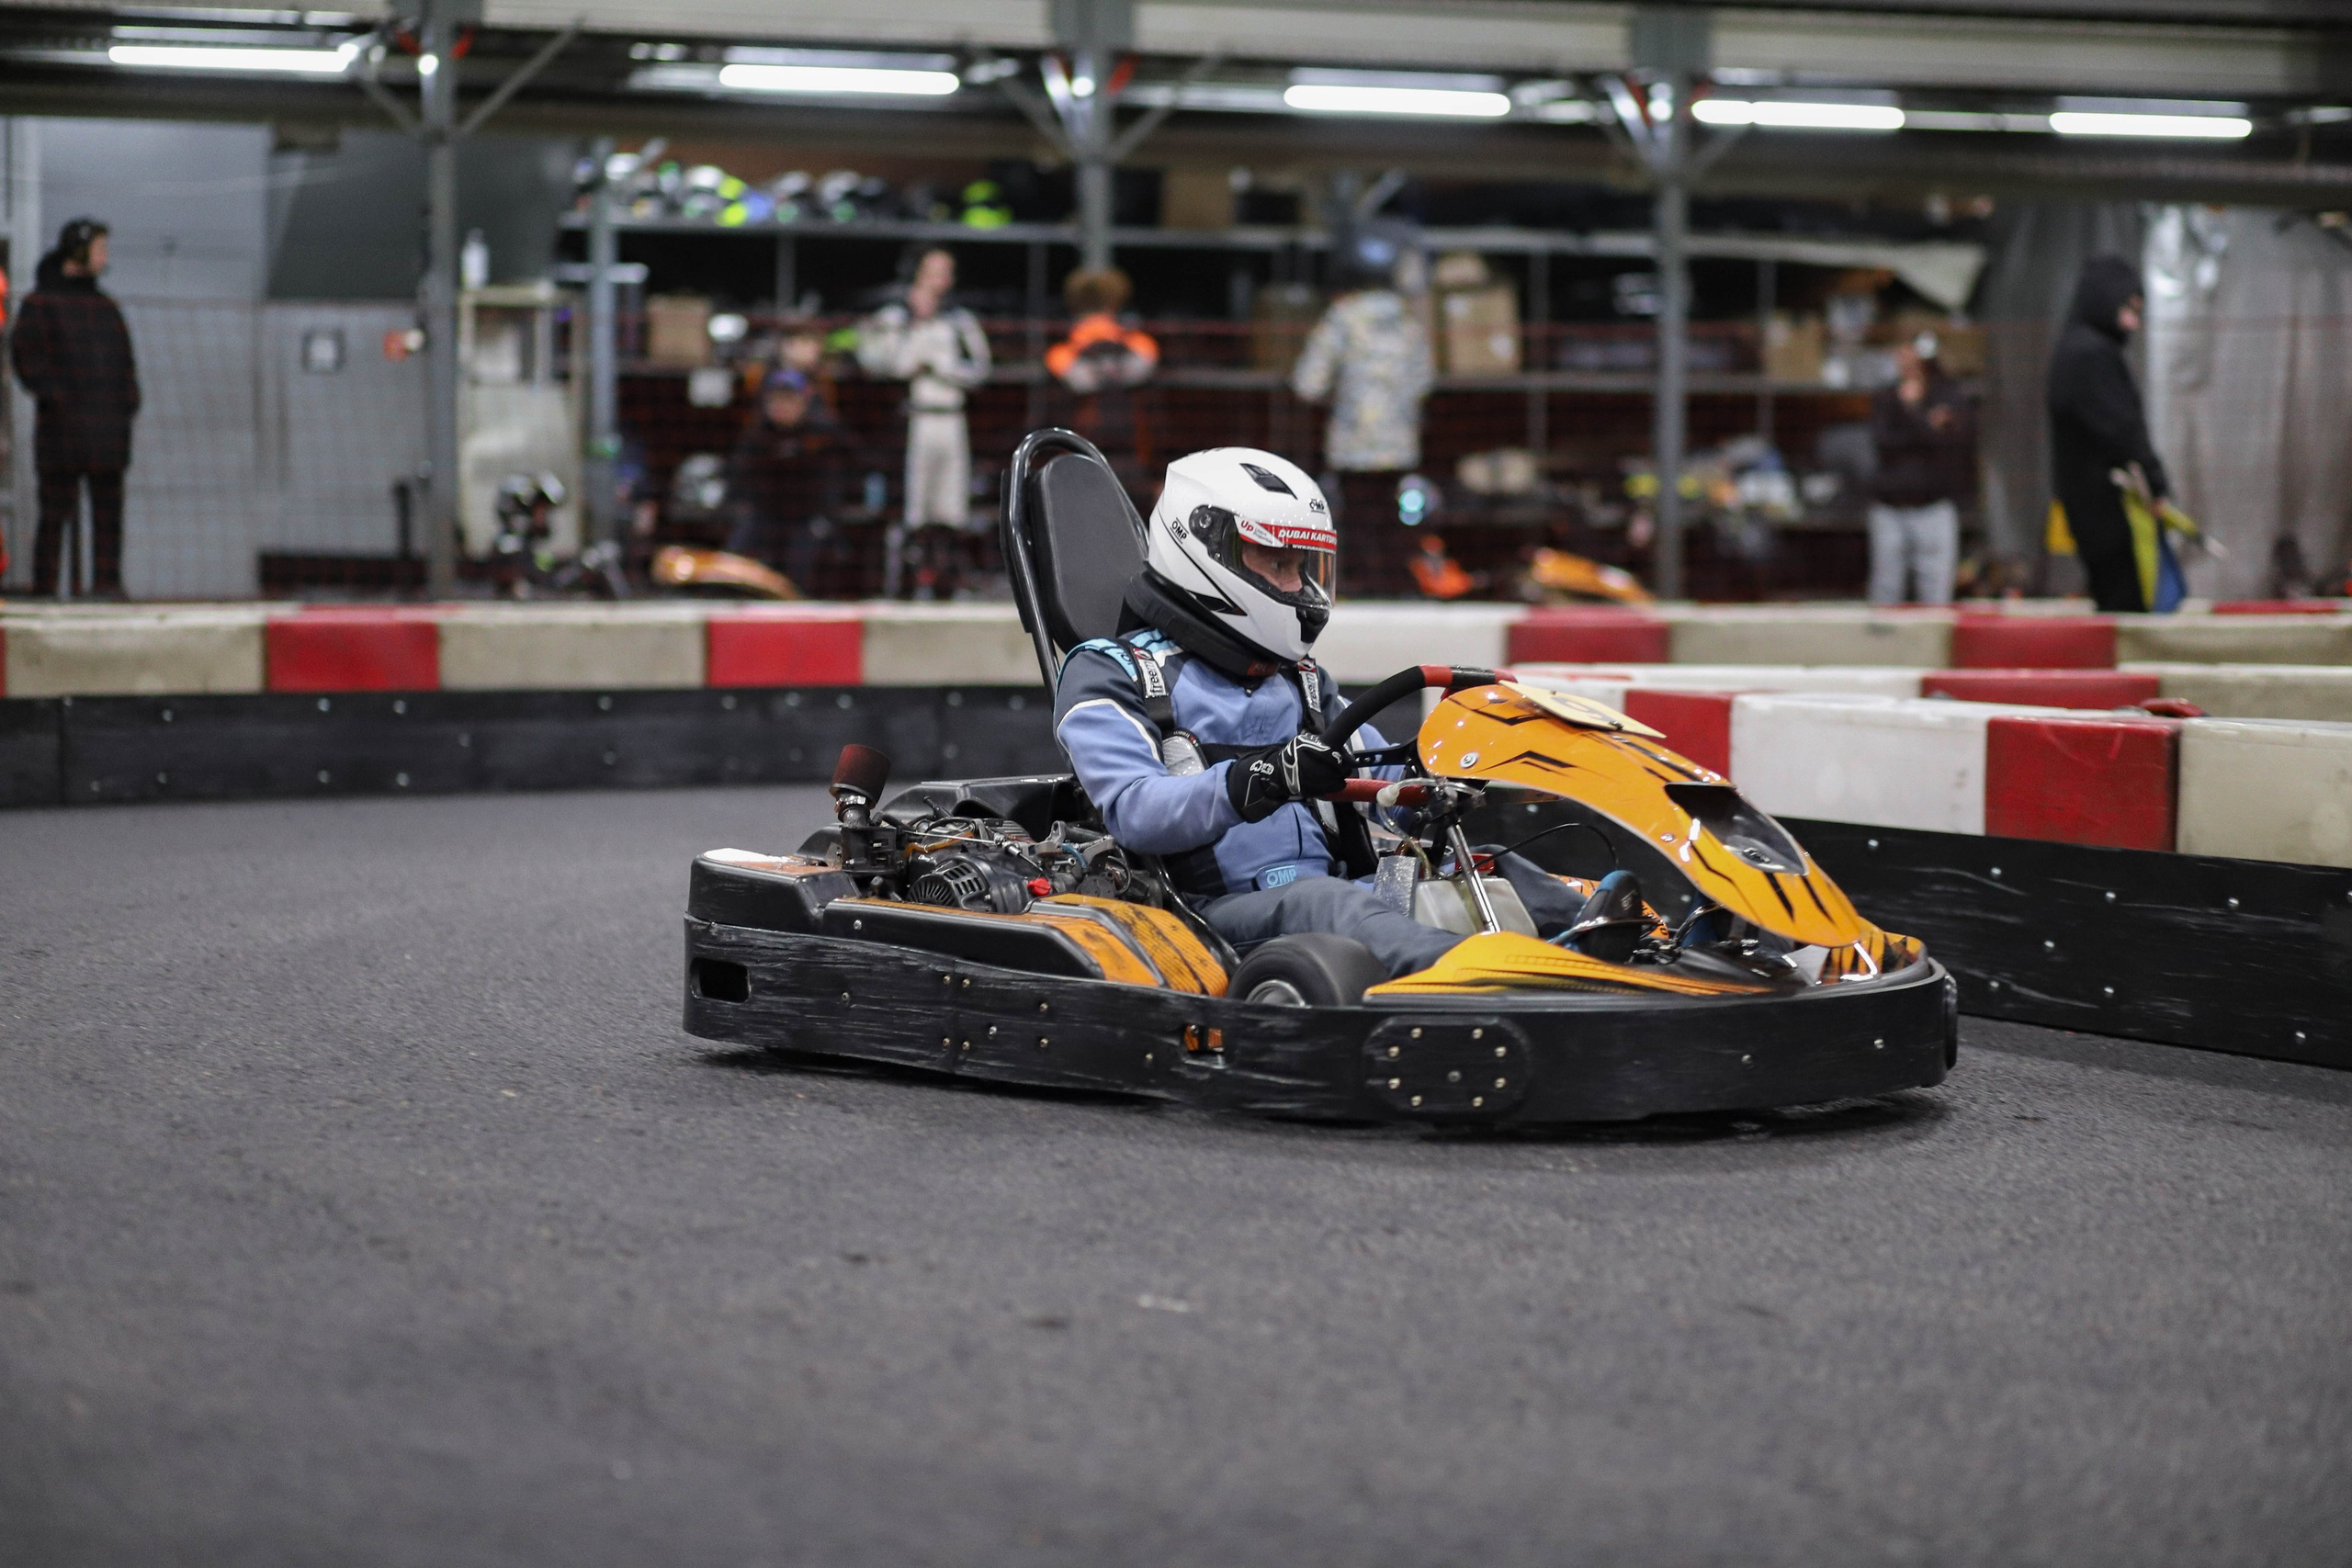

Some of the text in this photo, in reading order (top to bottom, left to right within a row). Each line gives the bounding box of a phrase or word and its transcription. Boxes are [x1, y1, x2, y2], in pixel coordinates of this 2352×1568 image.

[1171, 520, 1188, 540] OMP
[1240, 520, 1254, 531] Up
[1278, 529, 1310, 540] DUBAI
[1267, 868, 1296, 886] OMP
